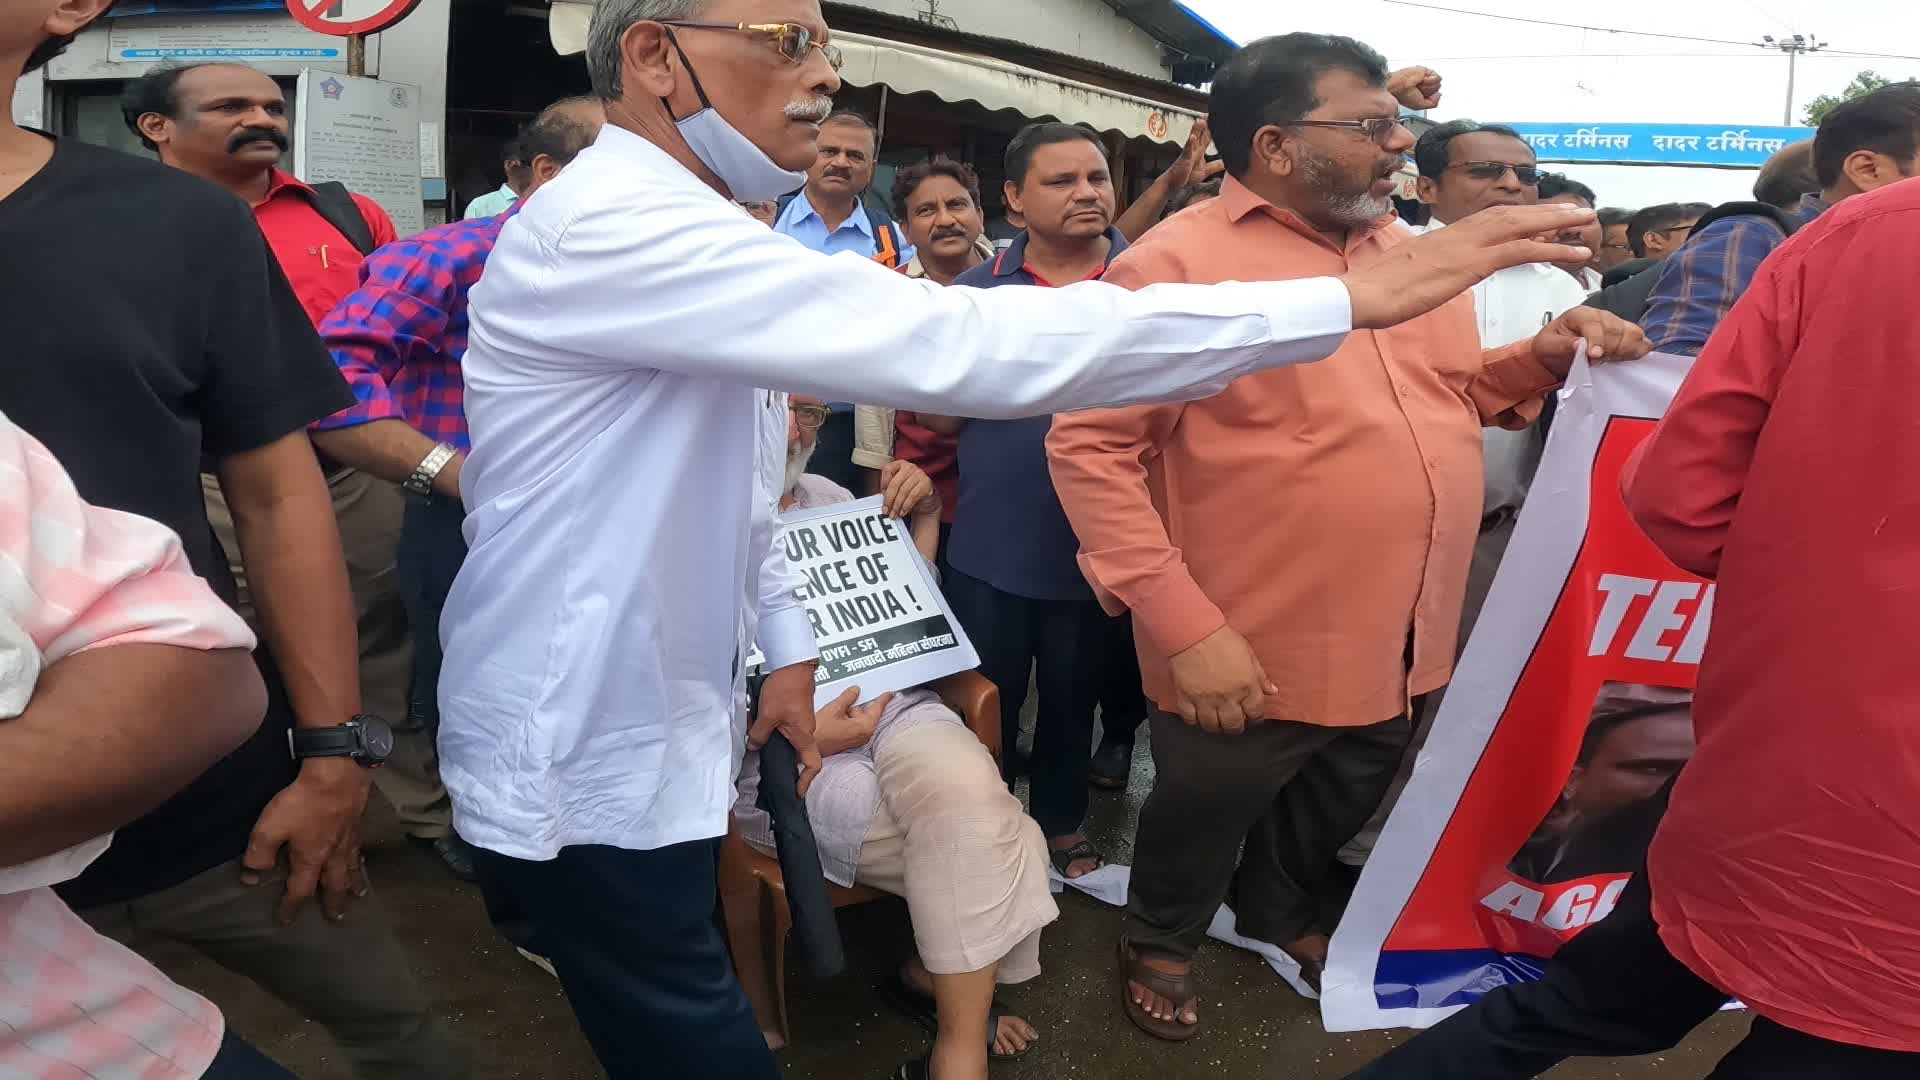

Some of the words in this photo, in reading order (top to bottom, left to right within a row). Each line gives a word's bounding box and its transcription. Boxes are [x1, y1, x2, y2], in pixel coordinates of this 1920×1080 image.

[1562, 127, 1632, 149] टर्मिनस
[1652, 135, 1701, 152] दादर
[1705, 129, 1787, 153] टर्मिनस
[821, 513, 898, 553] VOICE
[856, 552, 889, 585] OF
[827, 589, 908, 633] INDIA
[822, 645, 851, 662] DYFI
[857, 637, 879, 652] SFI
[841, 650, 887, 673] जनवादी
[885, 643, 922, 660] महिला
[918, 633, 955, 650] संघटना
